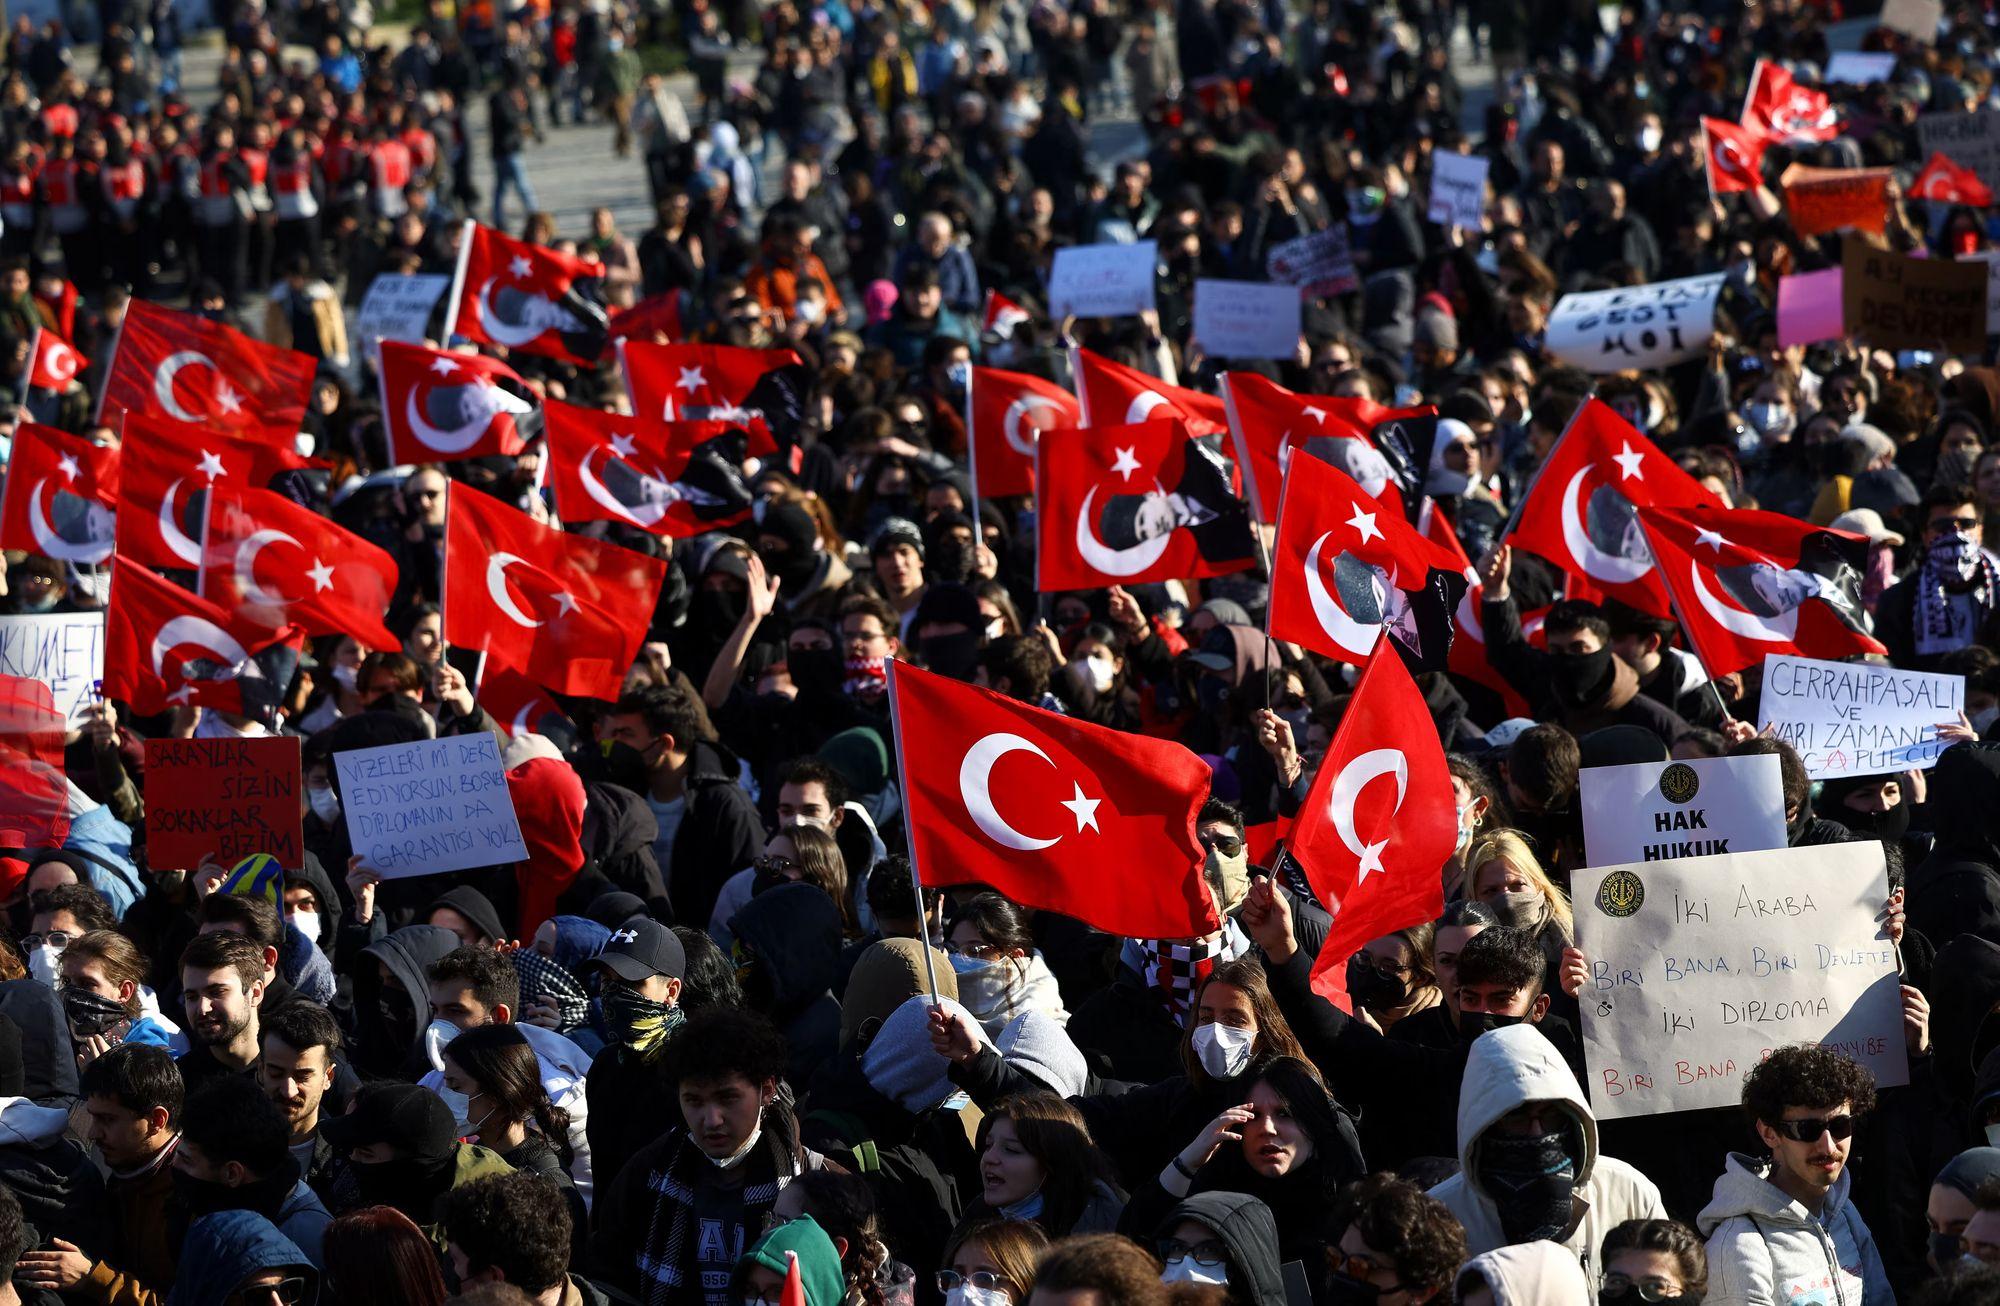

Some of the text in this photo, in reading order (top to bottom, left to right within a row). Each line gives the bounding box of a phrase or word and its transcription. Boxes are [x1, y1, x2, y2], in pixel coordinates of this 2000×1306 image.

[1771, 662, 1955, 710] CERRAHPAŞALI
[1833, 704, 1862, 721] VE
[150, 741, 255, 769] SARAYLAR
[343, 746, 425, 783] VİZELERİ
[459, 739, 498, 765] DERT
[221, 769, 292, 799] SİZİN
[152, 805, 269, 833] SOKAKLAR
[359, 800, 494, 838] DİPLOMANIN DA
[479, 818, 522, 849] YOK!
[1654, 809, 1708, 832] HAK
[1643, 839, 1729, 862] HUKUK
[1734, 884, 1818, 918] ARABA
[1815, 943, 1890, 971] DEVLETE
